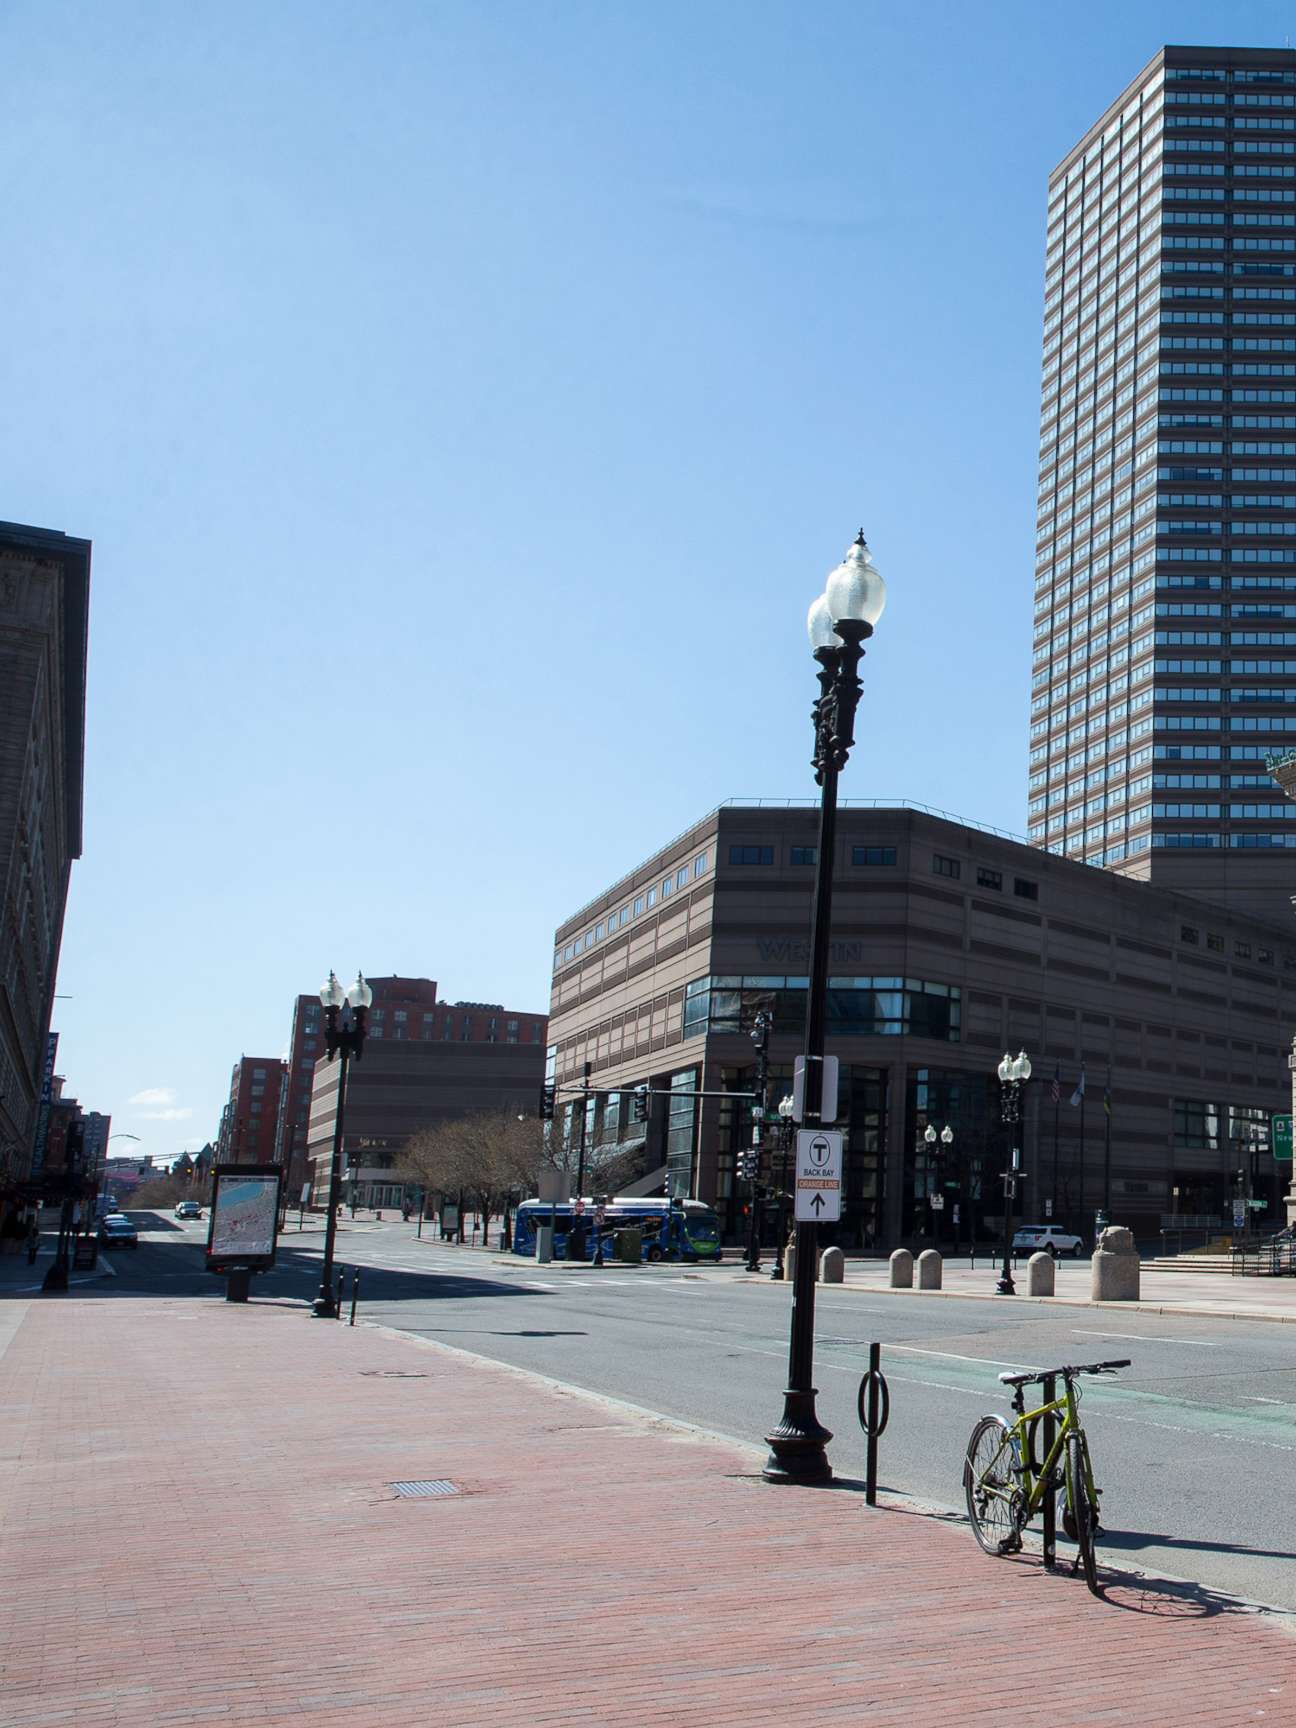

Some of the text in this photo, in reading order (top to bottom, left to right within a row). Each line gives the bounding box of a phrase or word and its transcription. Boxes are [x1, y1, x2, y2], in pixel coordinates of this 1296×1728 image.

[756, 936, 863, 961] WESIN
[813, 1144, 827, 1162] T
[804, 1169, 835, 1177] BACK BAY
[799, 1181, 839, 1189] ORANGE LINE
